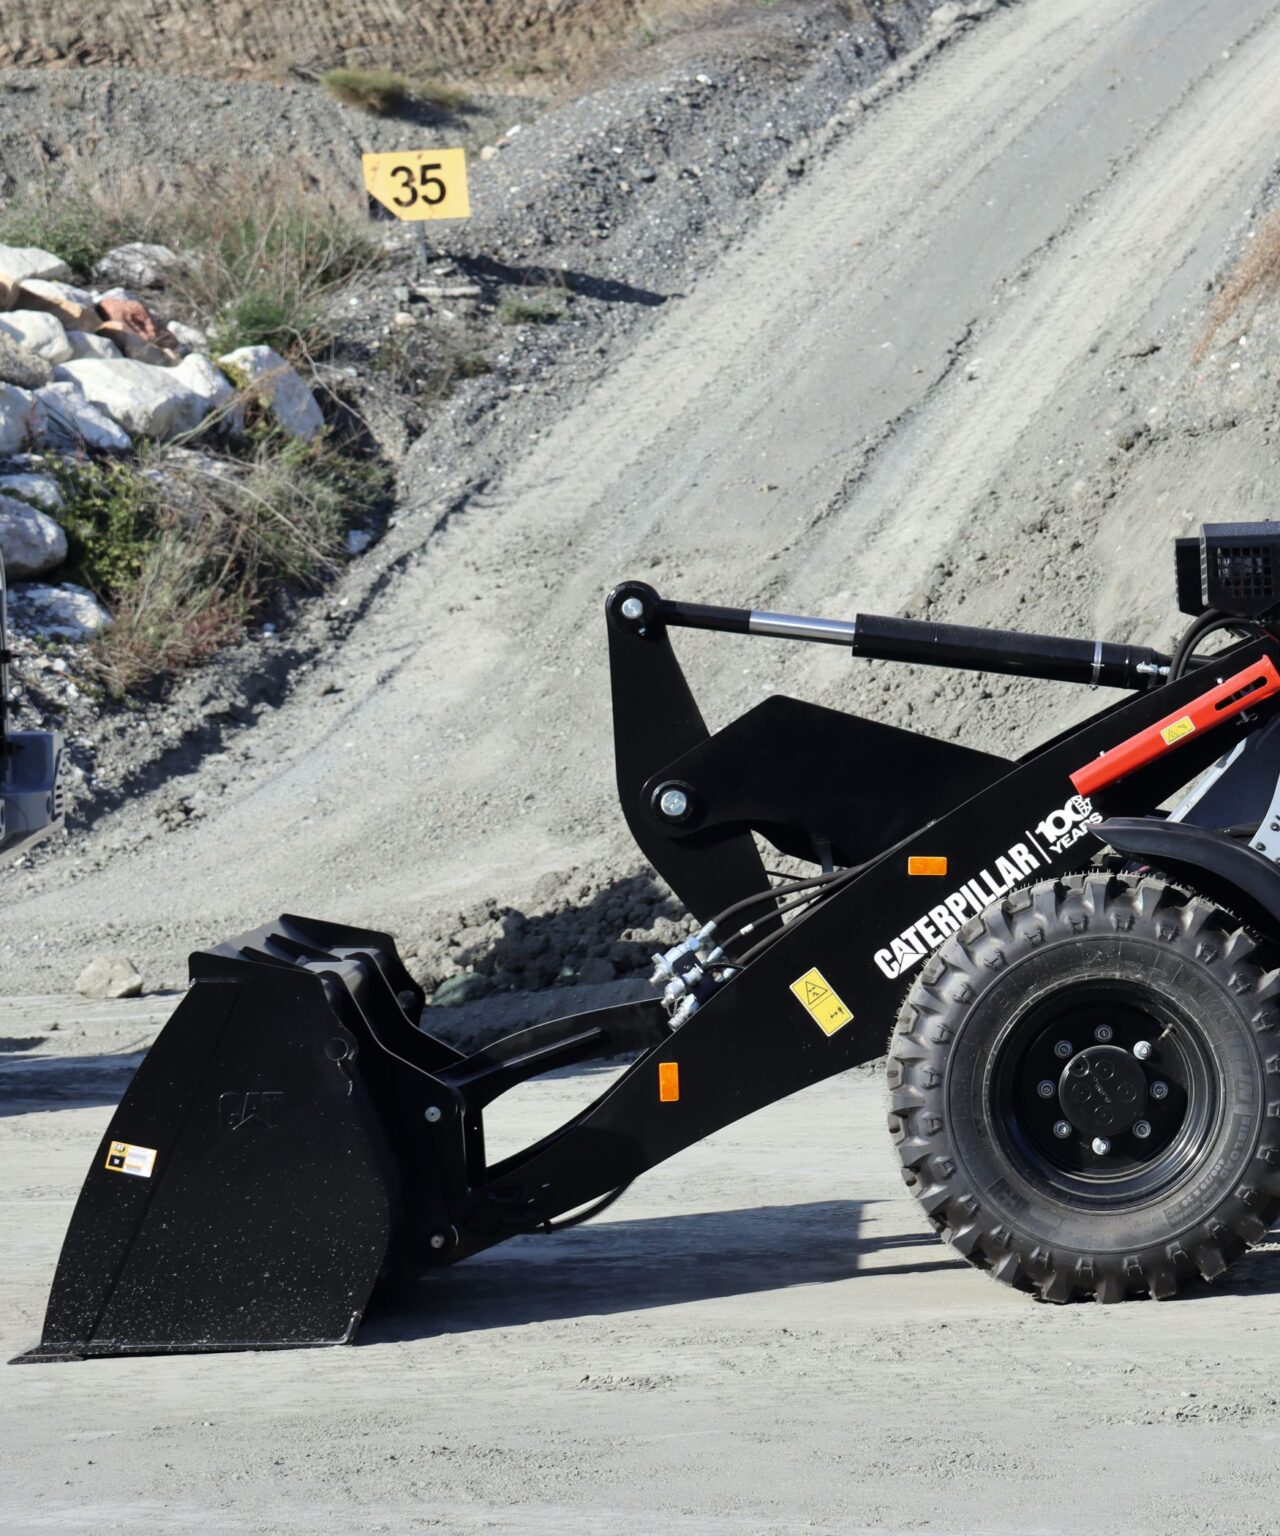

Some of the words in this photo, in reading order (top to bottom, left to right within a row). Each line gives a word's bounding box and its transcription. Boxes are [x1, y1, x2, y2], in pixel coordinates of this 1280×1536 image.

[390, 163, 447, 208] 35
[873, 842, 1040, 980] CATERPILLAR
[1034, 794, 1093, 844] 100
